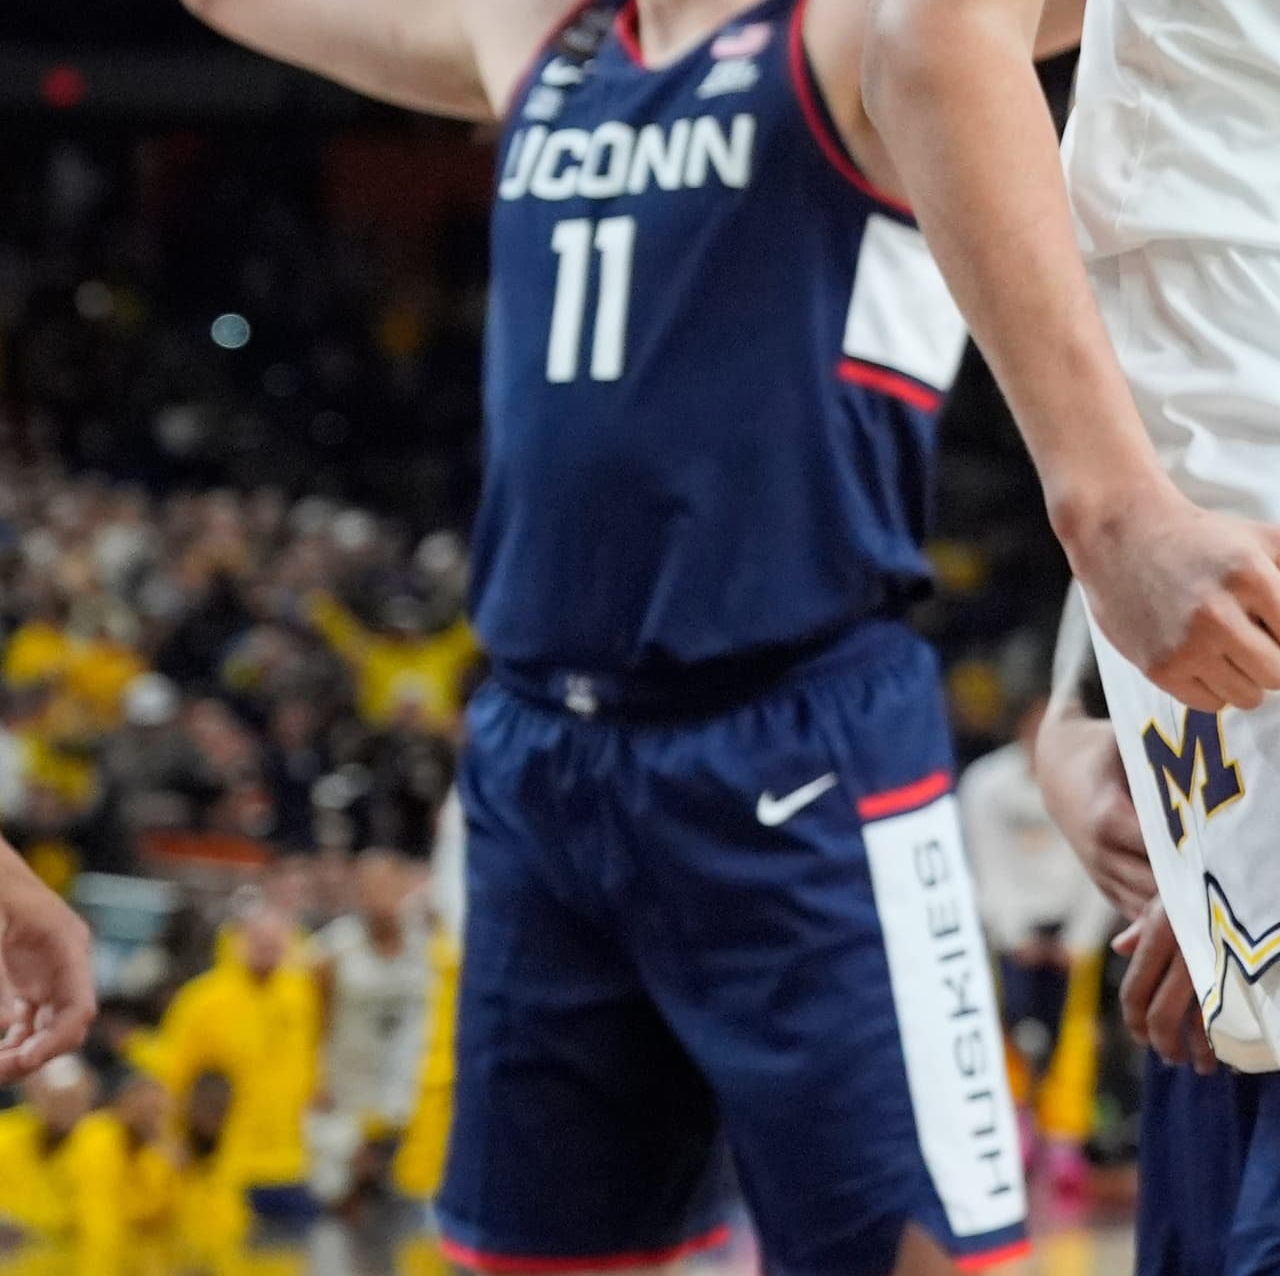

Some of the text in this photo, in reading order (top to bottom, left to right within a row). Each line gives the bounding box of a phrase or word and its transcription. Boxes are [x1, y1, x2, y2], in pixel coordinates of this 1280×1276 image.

[498, 112, 757, 201] UCONN
[546, 214, 636, 384] 11
[1141, 703, 1245, 852] M
[913, 837, 1012, 1197] HUSKIES
